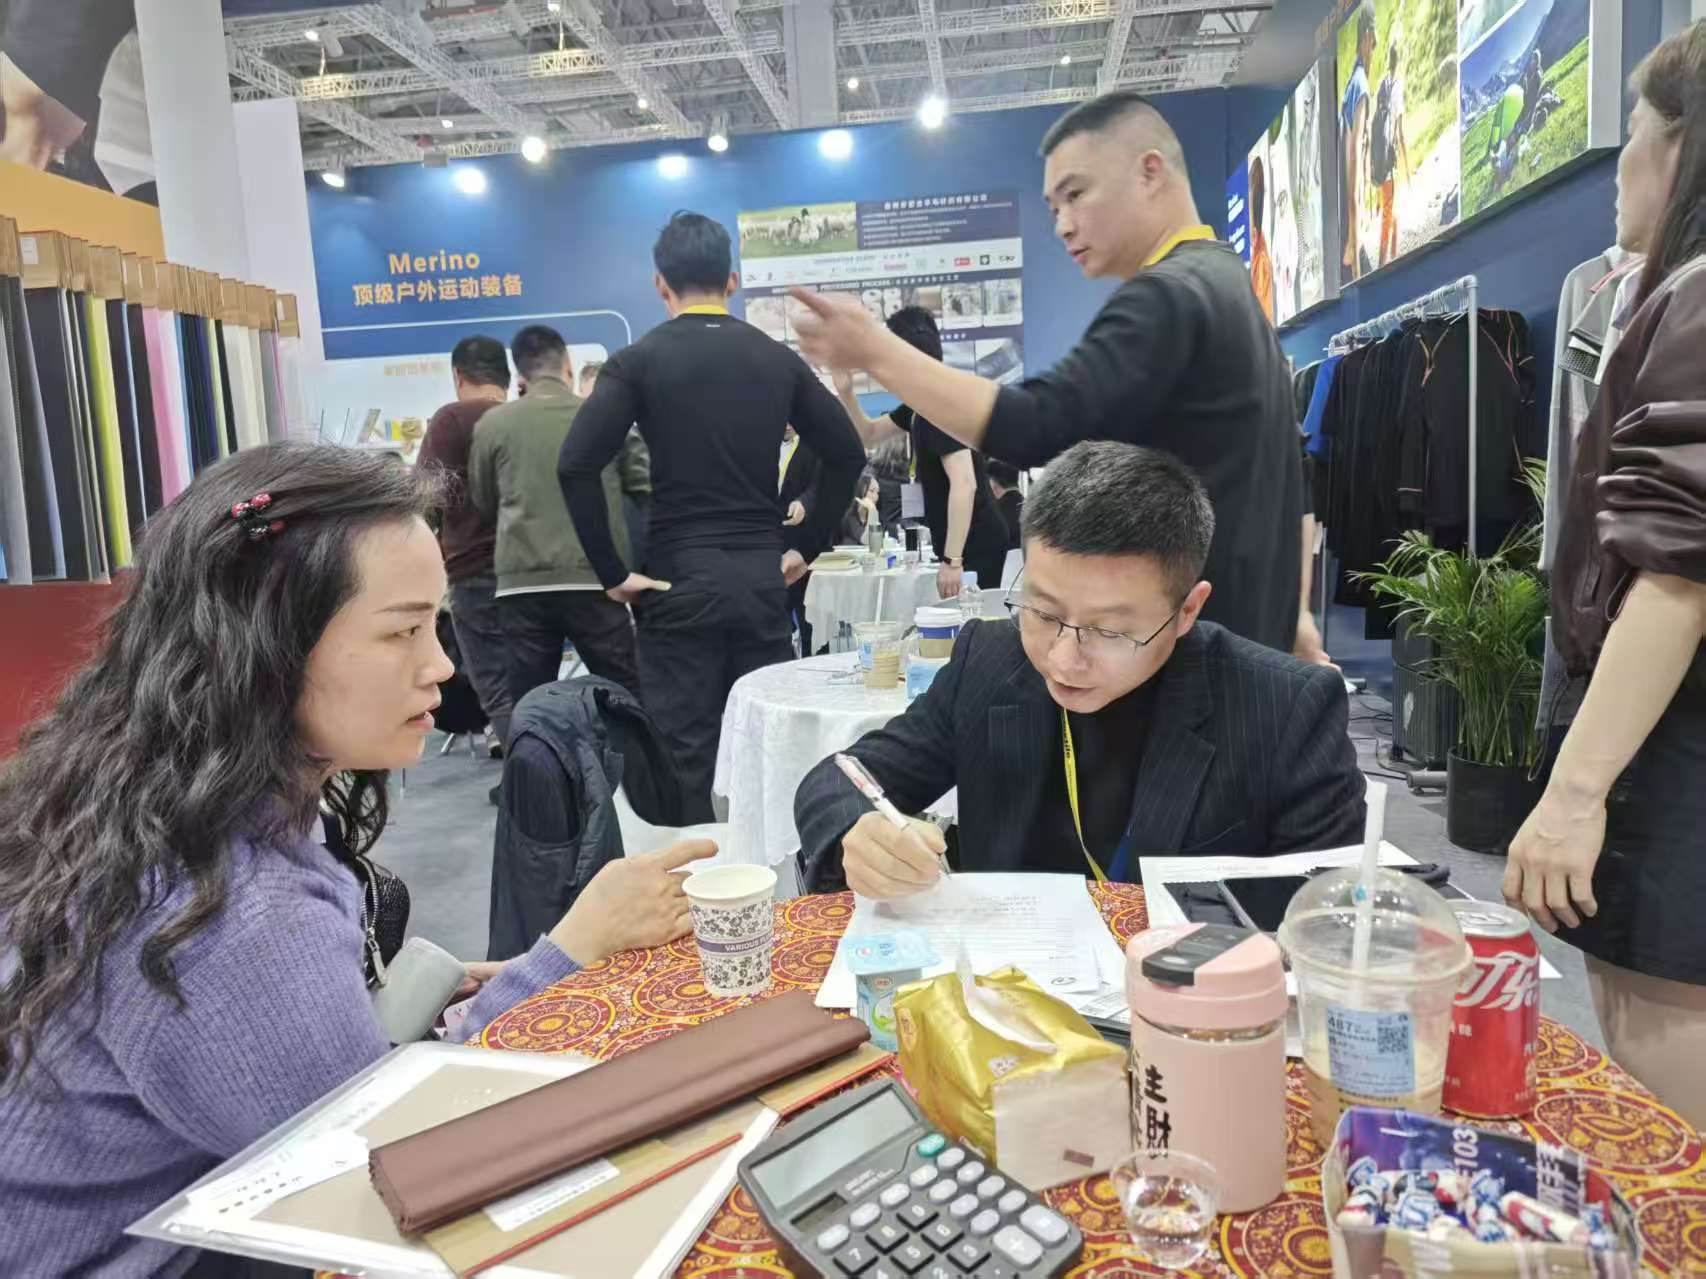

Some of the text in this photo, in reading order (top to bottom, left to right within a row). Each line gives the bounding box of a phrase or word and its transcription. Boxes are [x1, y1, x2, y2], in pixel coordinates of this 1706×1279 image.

[388, 249, 480, 274] Merino
[352, 273, 522, 306] 顶级户外运动装备
[725, 940, 759, 952] VARIOUS
